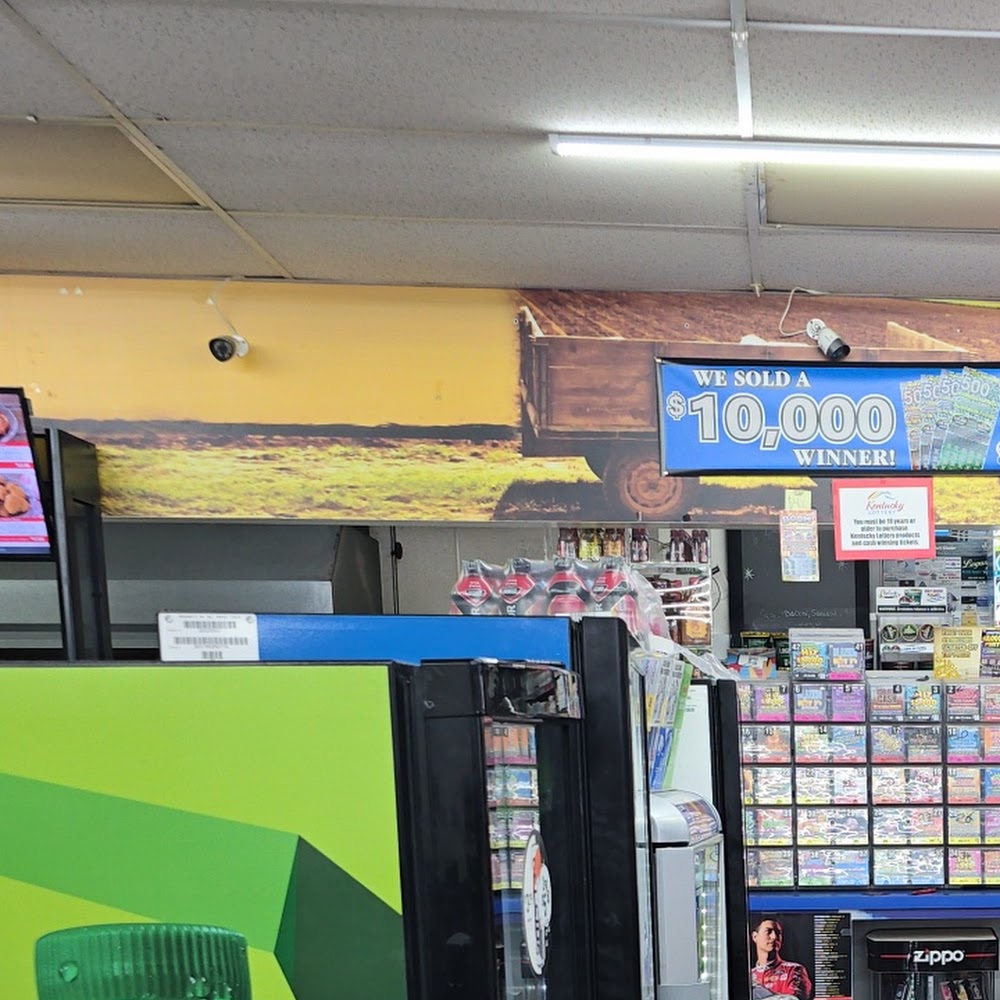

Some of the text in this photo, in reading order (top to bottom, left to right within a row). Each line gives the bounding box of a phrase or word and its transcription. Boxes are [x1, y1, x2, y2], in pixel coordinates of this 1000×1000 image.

[693, 370, 811, 387] WE SOLD A
[666, 391, 897, 450] $10,000
[793, 449, 896, 467] WINNER!
